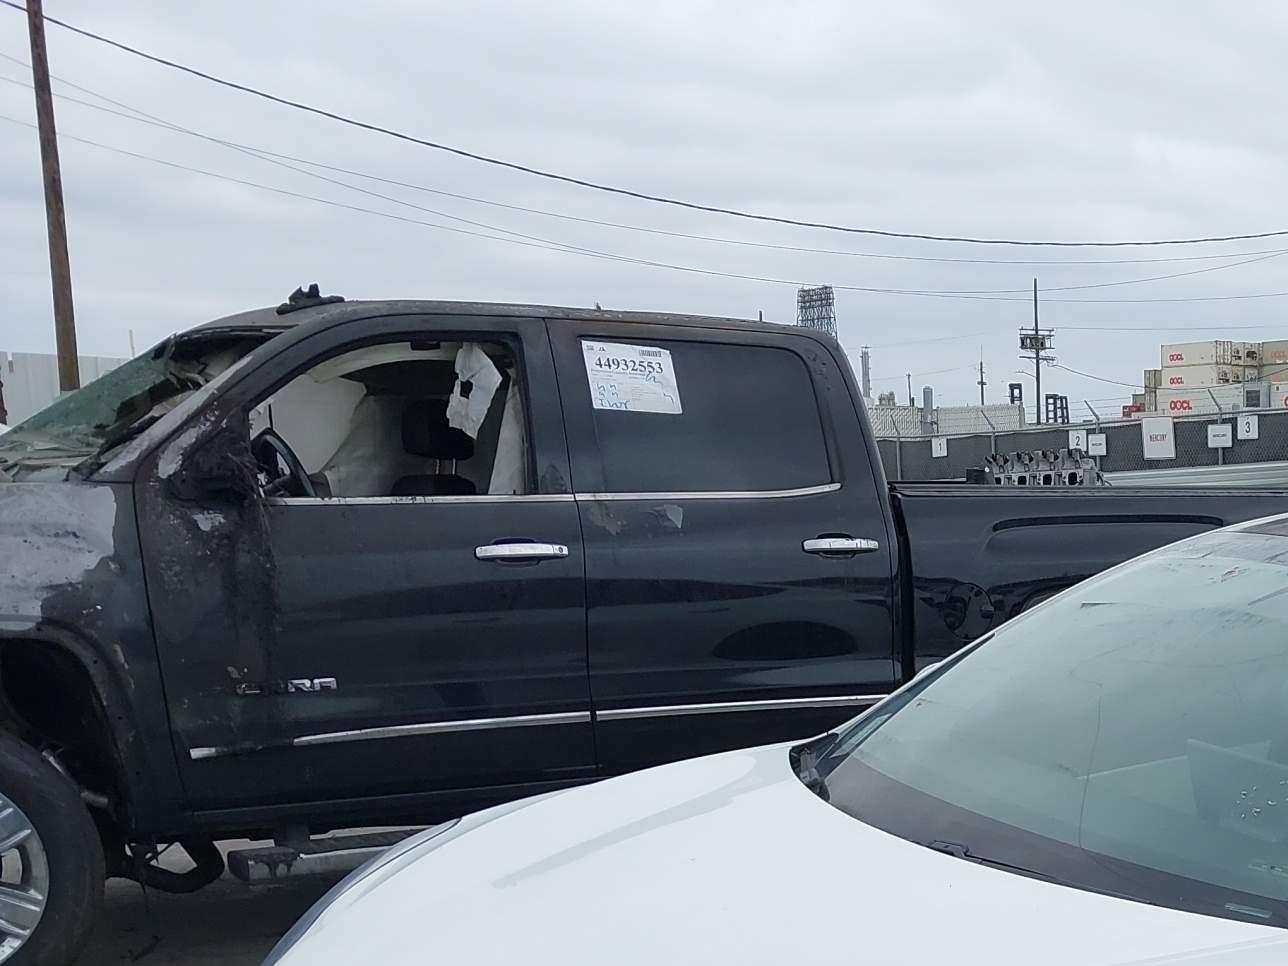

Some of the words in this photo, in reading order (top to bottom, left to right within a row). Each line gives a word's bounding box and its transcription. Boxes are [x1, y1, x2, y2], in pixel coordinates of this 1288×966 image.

[595, 356, 664, 374] 44932553
[1169, 399, 1192, 412] OOCL
[1244, 421, 1251, 434] 3
[1075, 435, 1081, 447] 2
